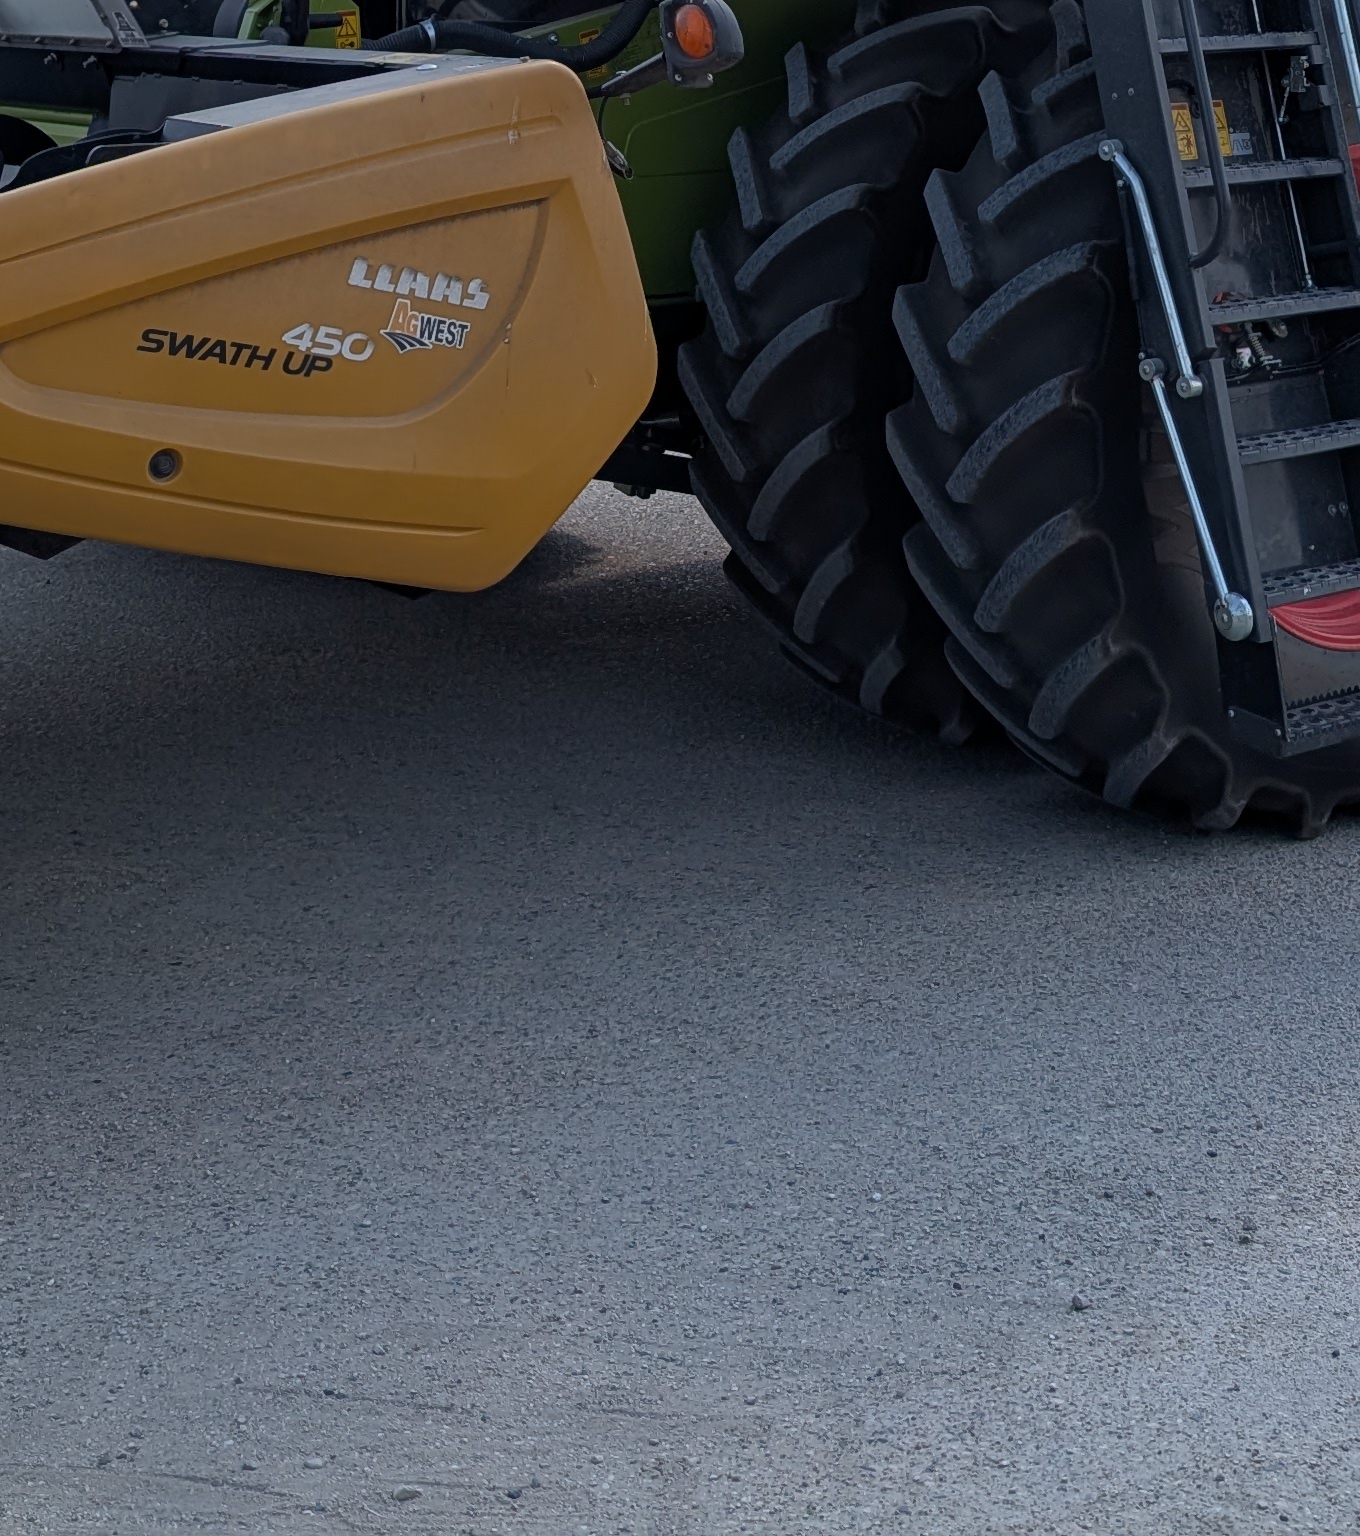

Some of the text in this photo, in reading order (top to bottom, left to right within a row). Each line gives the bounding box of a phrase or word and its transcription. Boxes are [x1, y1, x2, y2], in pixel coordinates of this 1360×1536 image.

[137, 328, 334, 378] SWATH UP
[282, 322, 375, 362] 450
